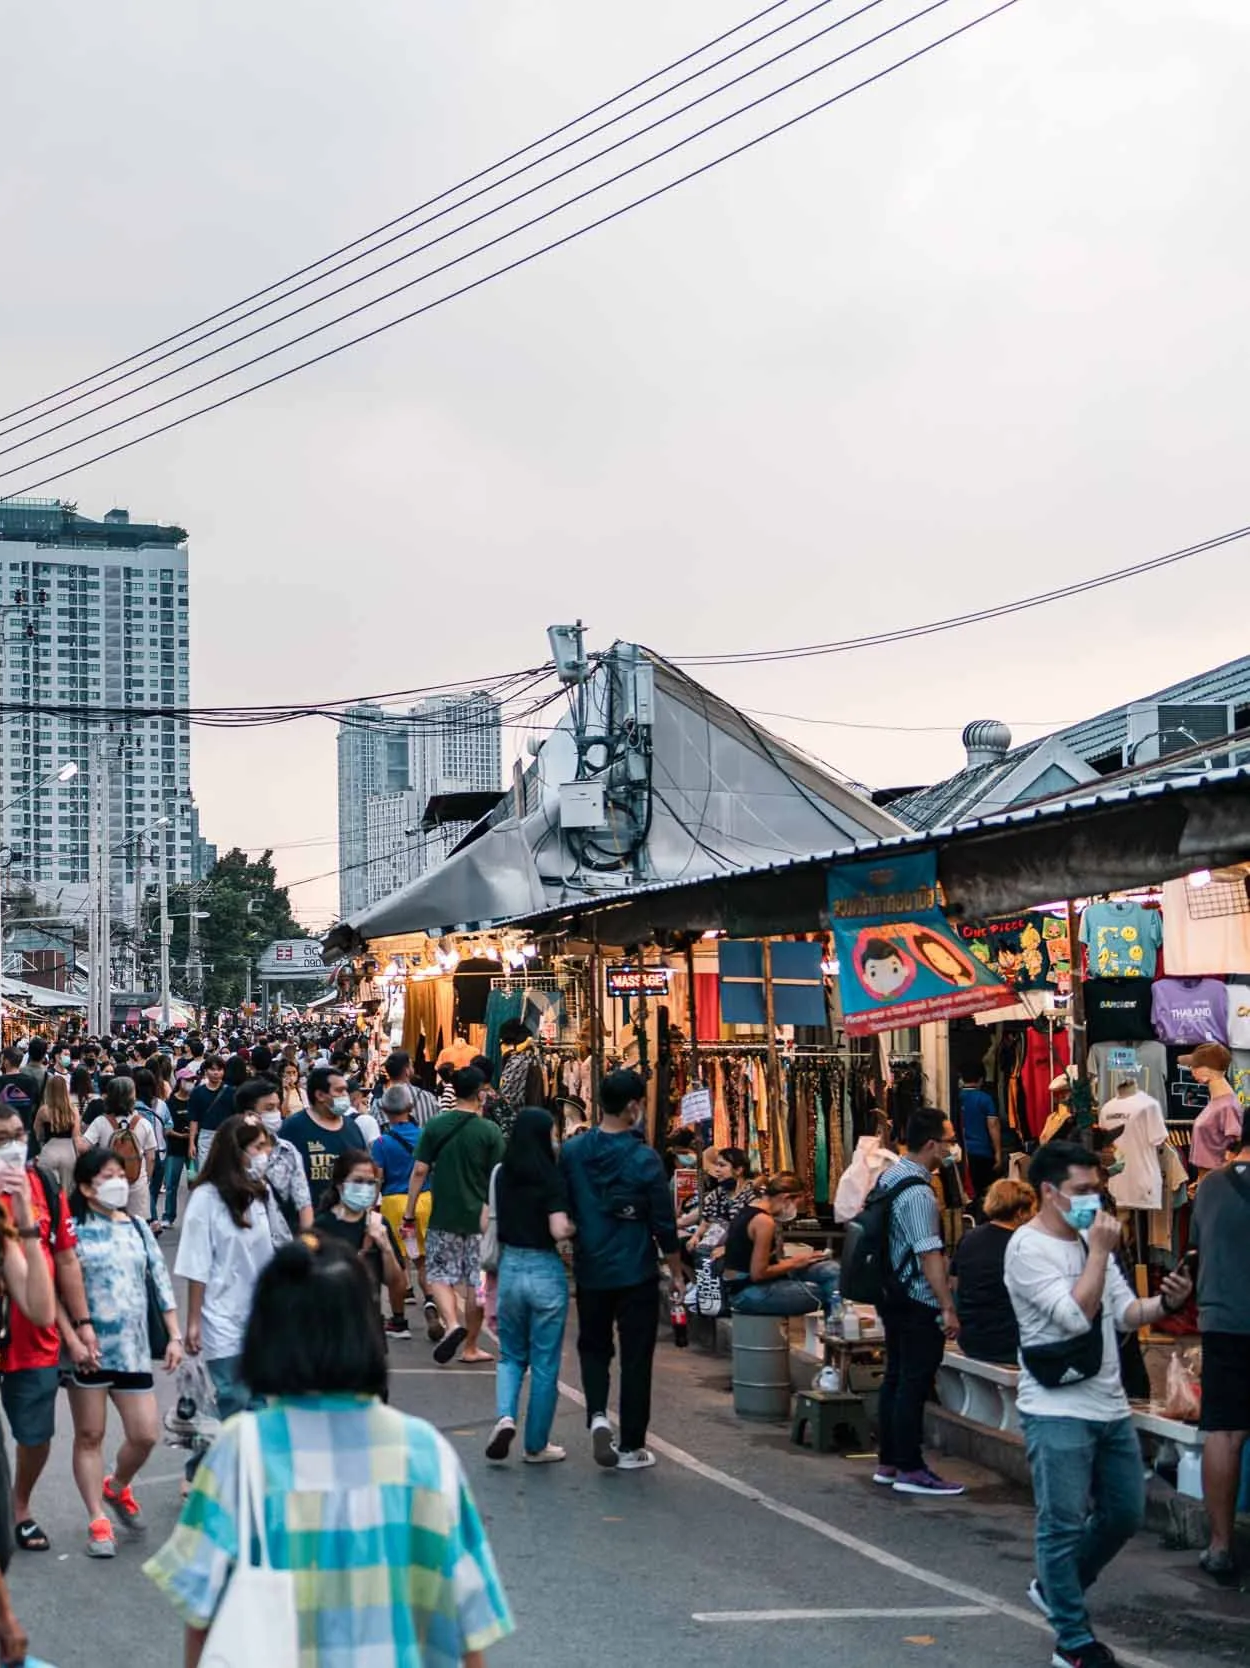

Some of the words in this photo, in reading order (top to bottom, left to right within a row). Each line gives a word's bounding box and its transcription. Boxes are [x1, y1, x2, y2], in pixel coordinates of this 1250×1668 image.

[611, 974, 665, 988] MASSAGE
[1171, 1006, 1212, 1019] THAILAND
[702, 1258, 711, 1298] NORTH
